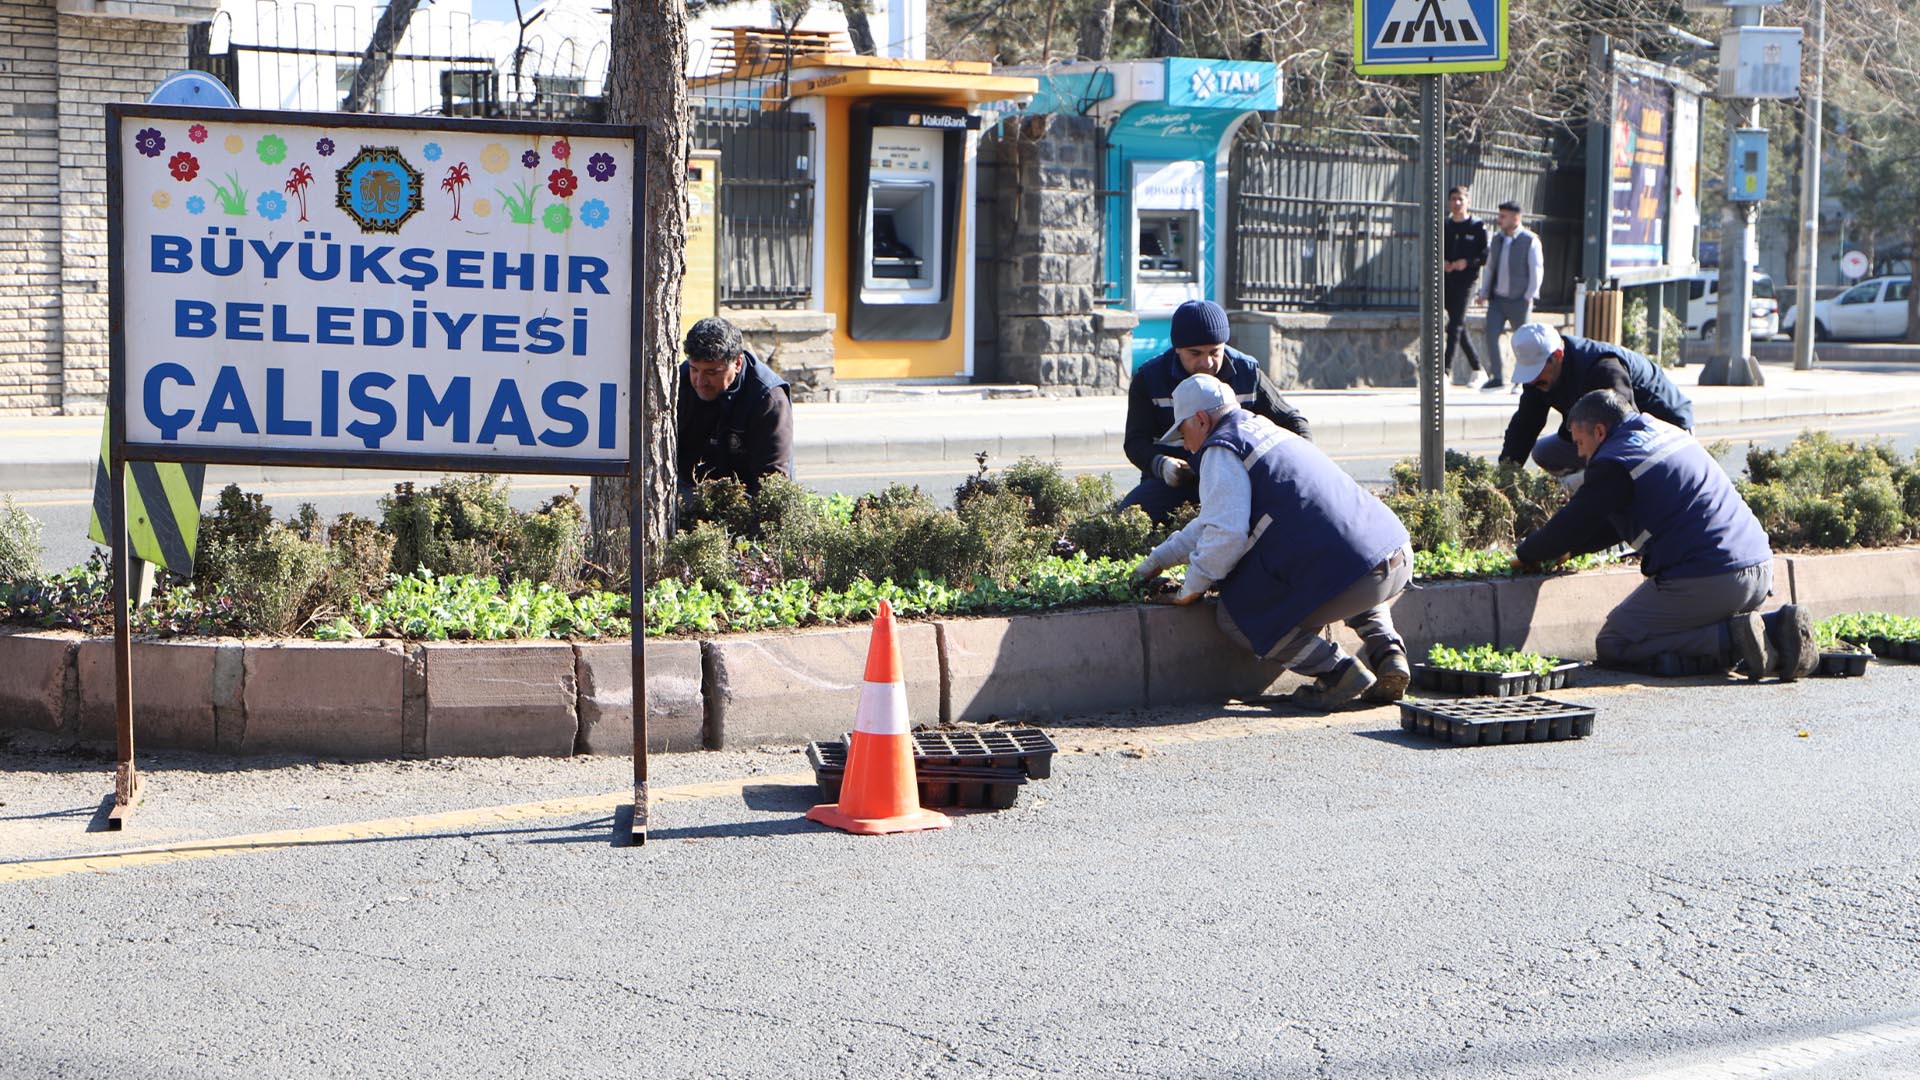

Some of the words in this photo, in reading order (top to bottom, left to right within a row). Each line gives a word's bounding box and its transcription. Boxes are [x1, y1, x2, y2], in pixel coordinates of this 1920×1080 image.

[1217, 71, 1260, 92] TAM
[922, 114, 968, 128] VakıfBank
[150, 226, 609, 295] BÜYÜKŞEHIR
[174, 299, 588, 356] BELEDİYESİ
[143, 361, 617, 449] ÇALIŞMASI
